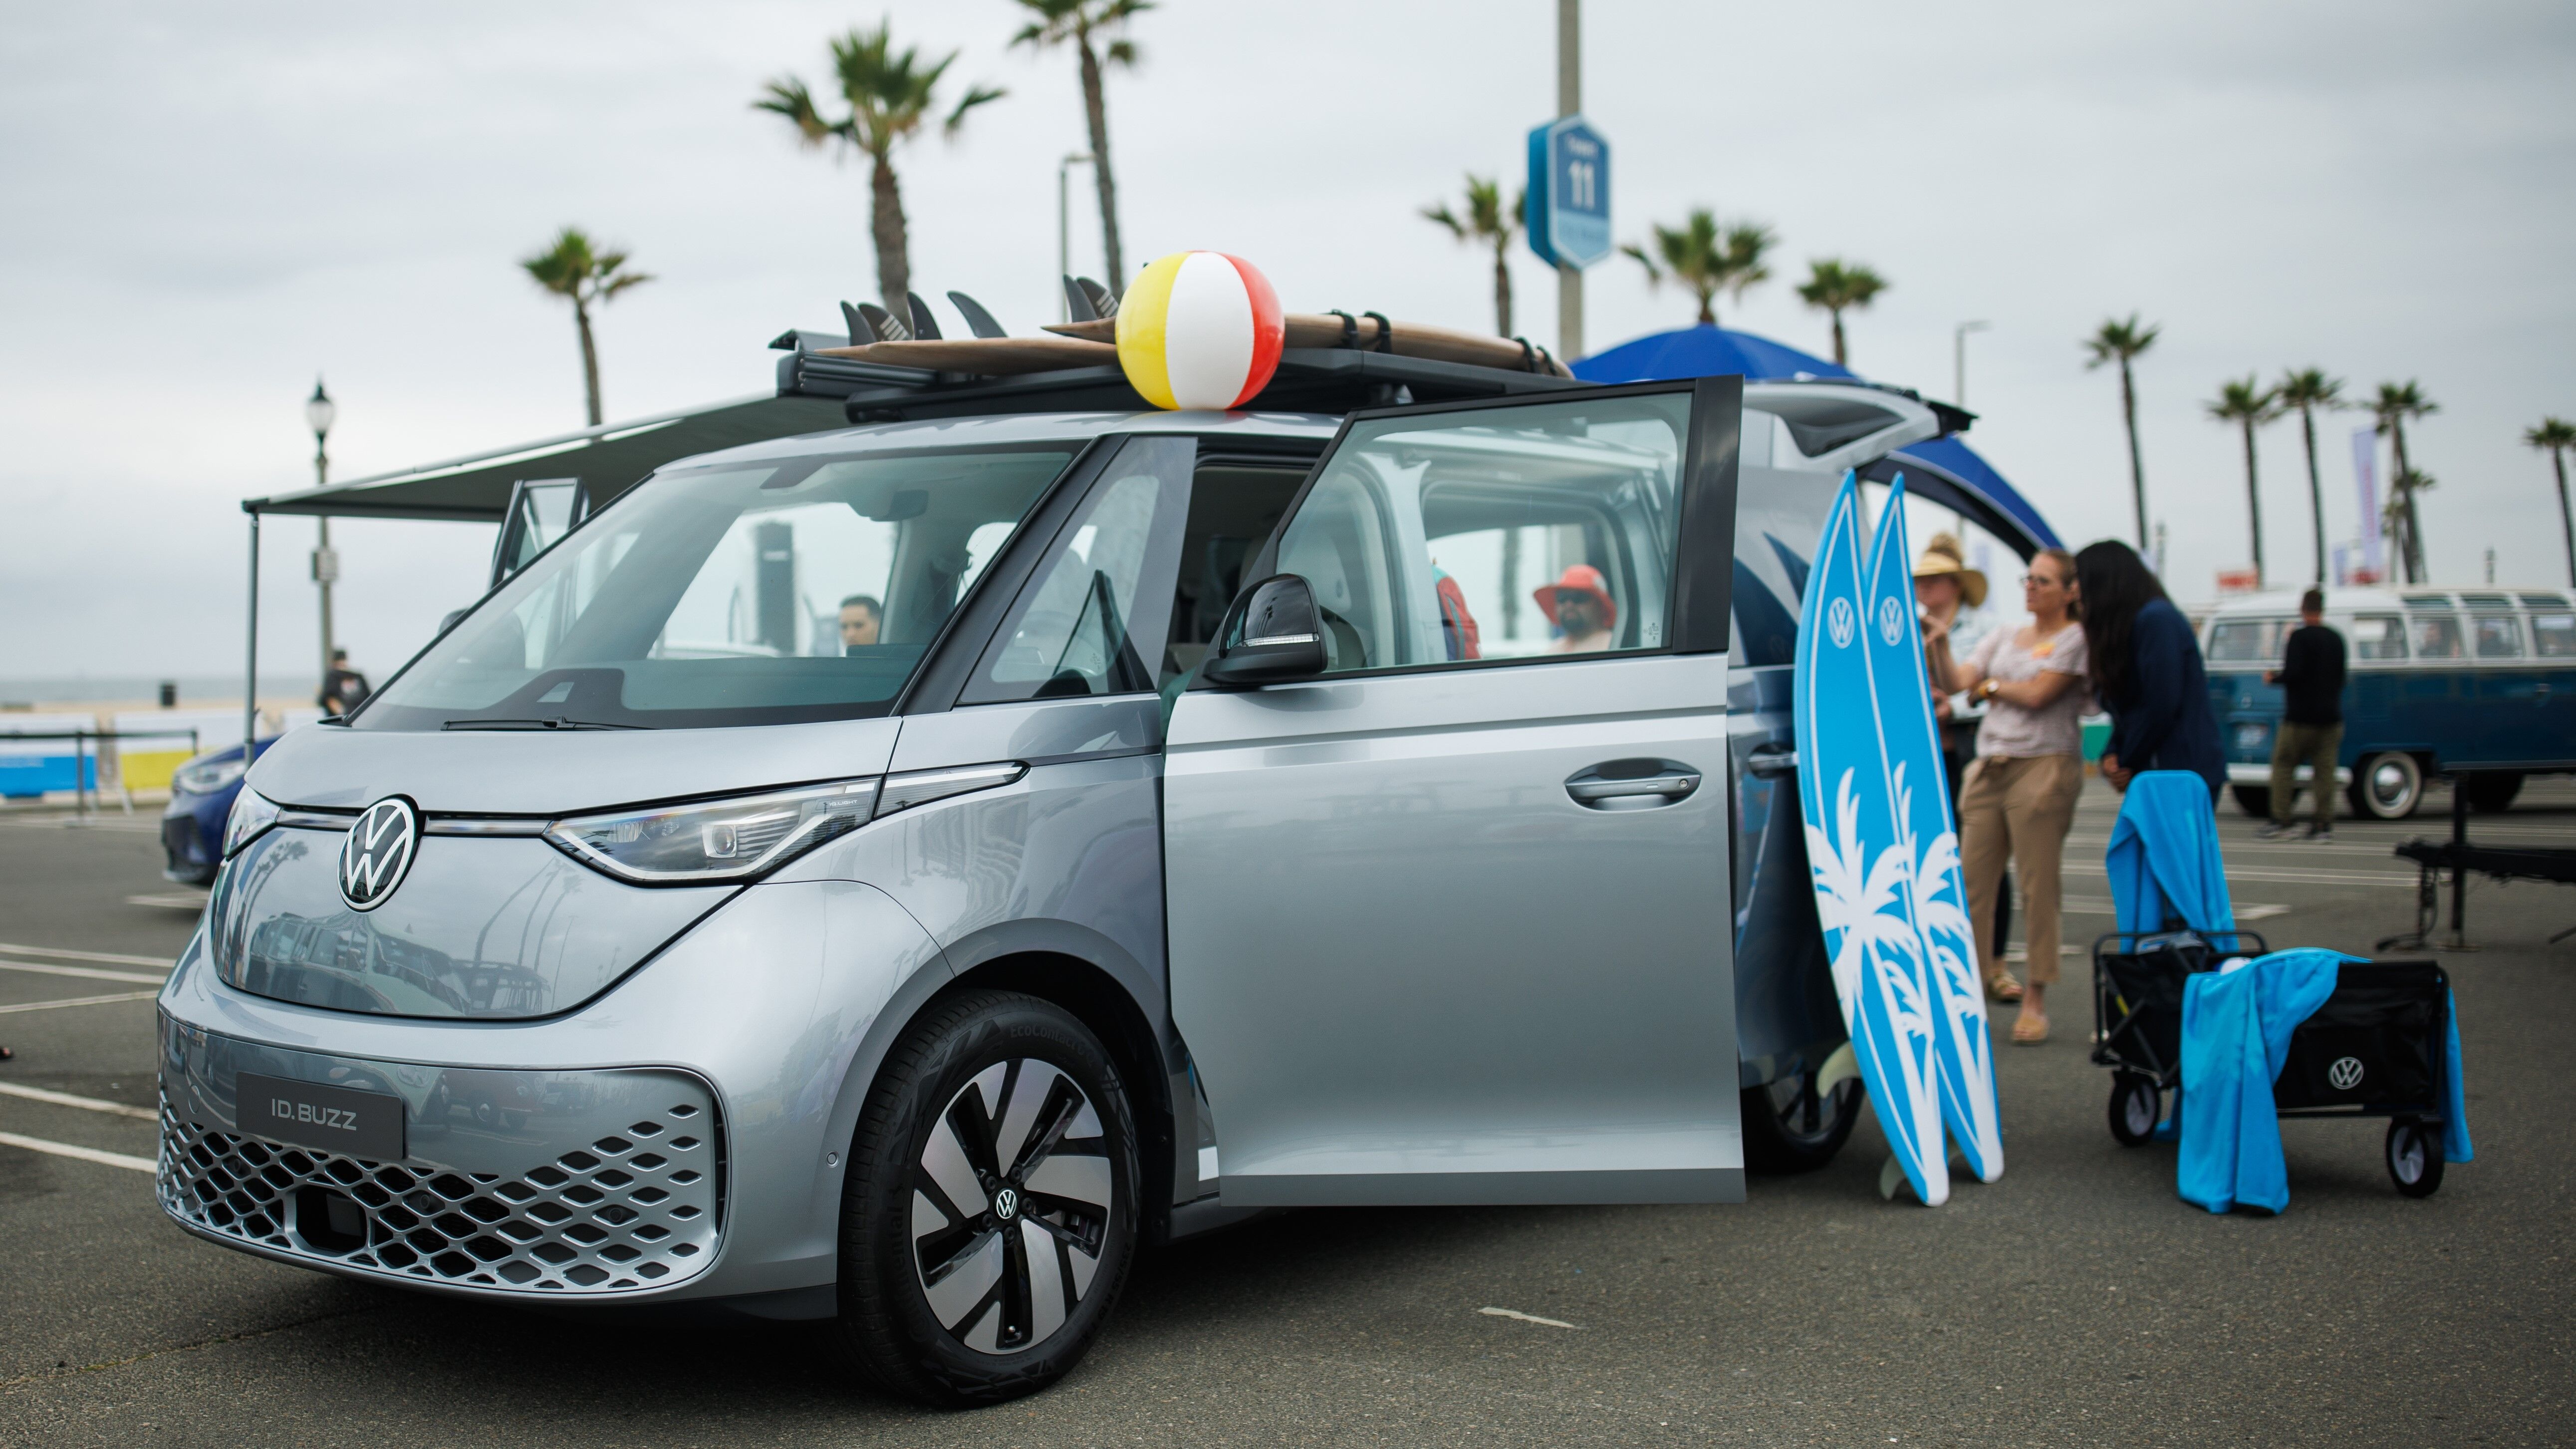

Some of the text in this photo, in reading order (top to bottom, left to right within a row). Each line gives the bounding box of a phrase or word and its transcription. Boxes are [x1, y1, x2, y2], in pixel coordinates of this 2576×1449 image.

[1568, 160, 1594, 210] 11
[1828, 597, 1854, 647] VW
[1880, 597, 1903, 645] VW
[340, 800, 411, 901] VW
[2331, 1058, 2362, 1087] VW
[997, 1190, 1017, 1218] VW
